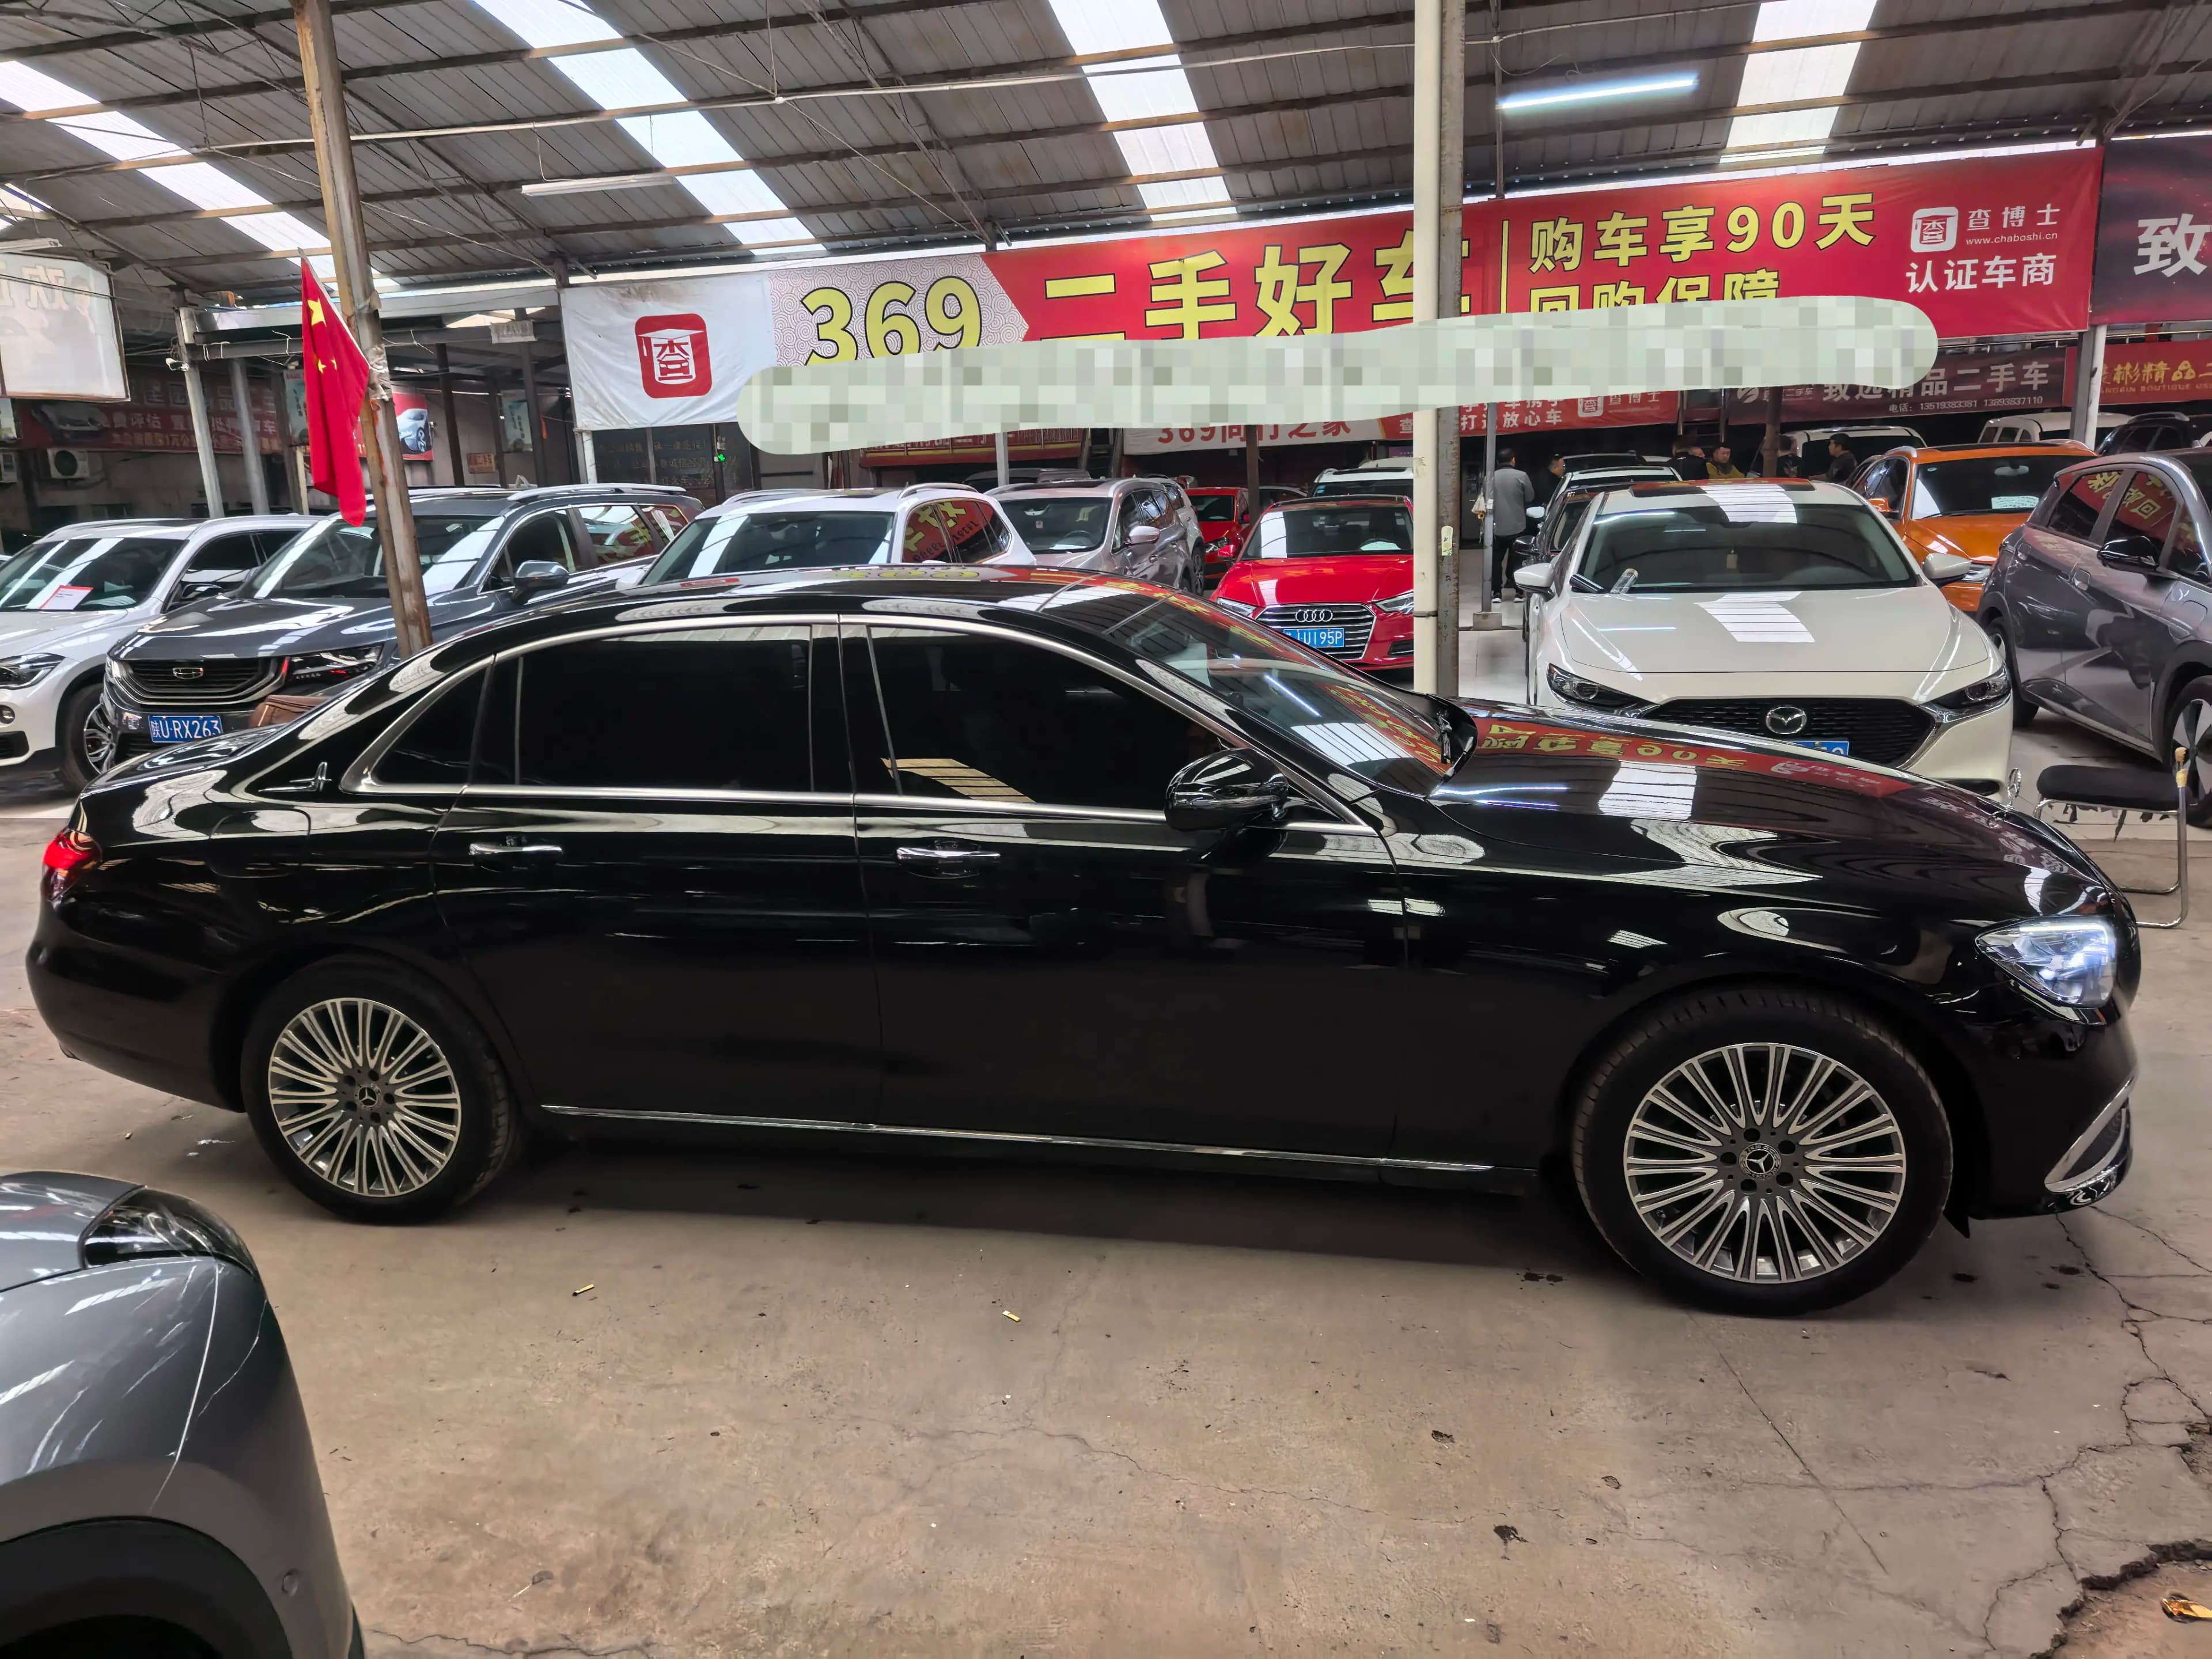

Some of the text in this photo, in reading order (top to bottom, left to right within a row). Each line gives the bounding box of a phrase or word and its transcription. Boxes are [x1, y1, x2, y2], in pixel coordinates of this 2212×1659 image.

[1529, 191, 1877, 274] 购车享90天
[1966, 232, 2058, 245] www.chaboshi.cn
[1967, 203, 2061, 231] 查博士
[2134, 213, 2212, 278] 致
[1906, 253, 2056, 294] 认证车商
[800, 275, 982, 365] 369
